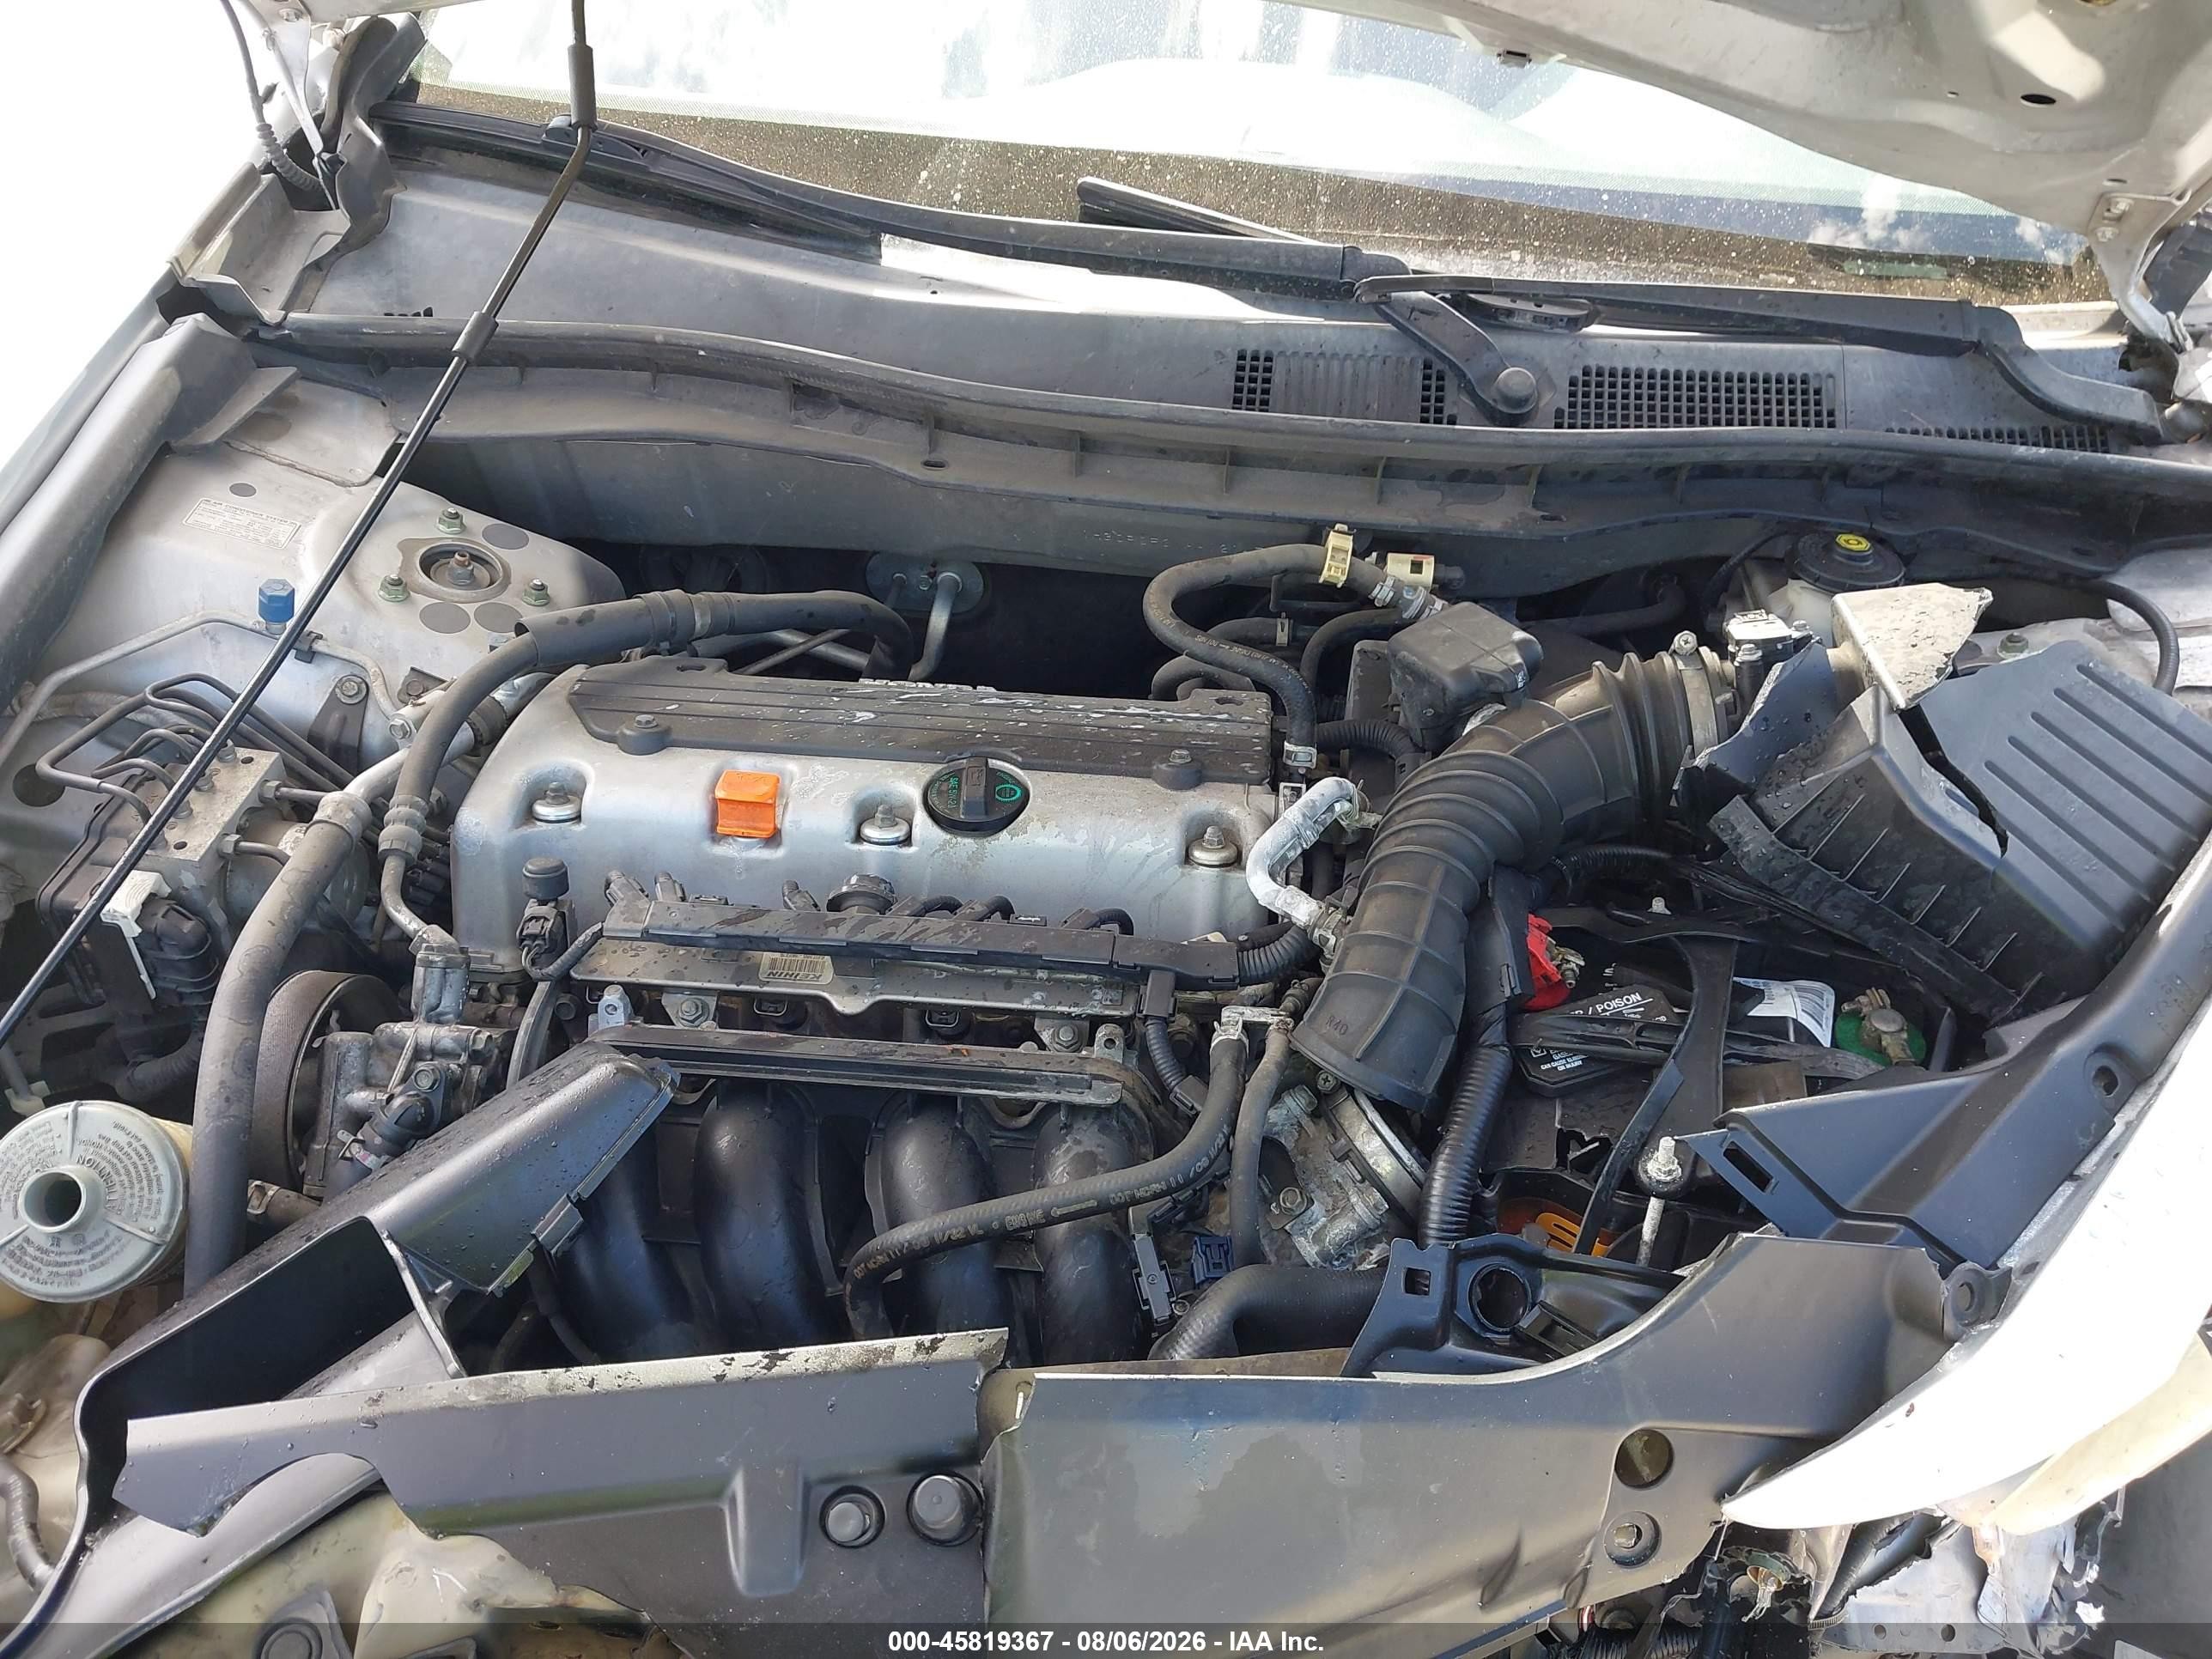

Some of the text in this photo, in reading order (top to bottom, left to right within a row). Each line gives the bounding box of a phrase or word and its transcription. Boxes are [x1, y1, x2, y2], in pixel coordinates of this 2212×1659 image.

[947, 776, 959, 789] SAE
[767, 970, 823, 981] KEIHIN
[1595, 992, 1643, 1013] POISON
[76, 1153, 119, 1214] ATTENTION
